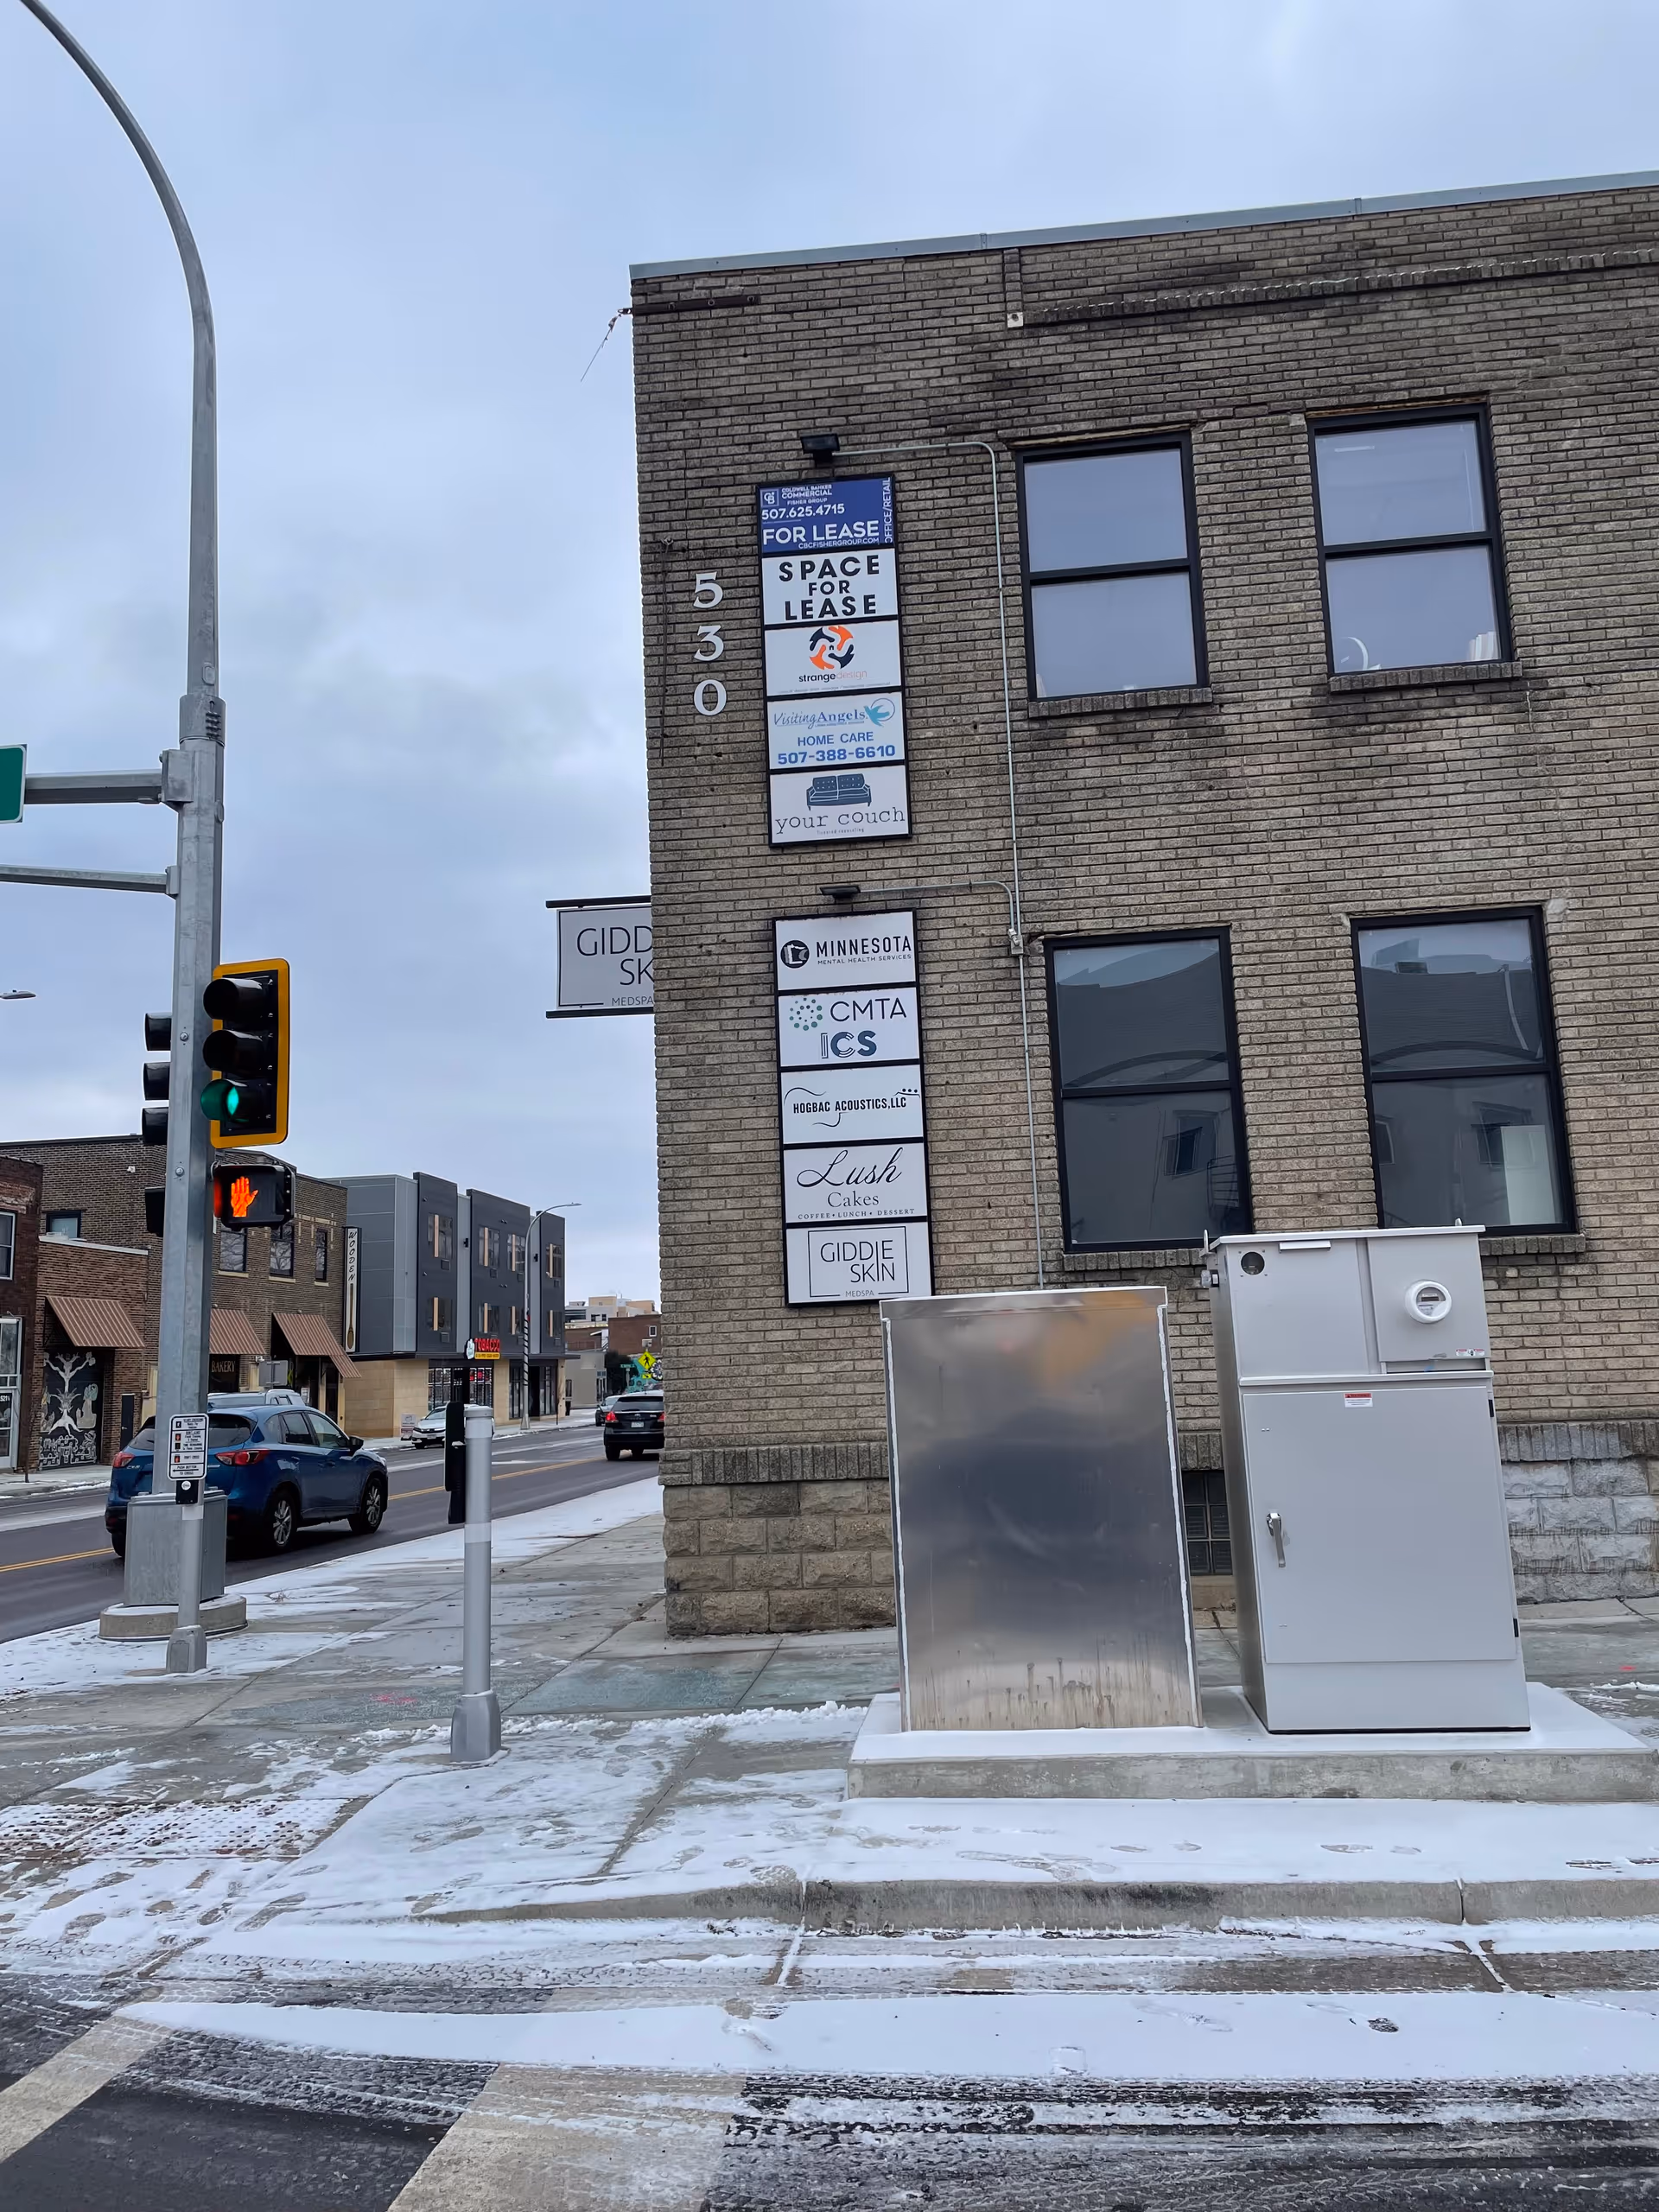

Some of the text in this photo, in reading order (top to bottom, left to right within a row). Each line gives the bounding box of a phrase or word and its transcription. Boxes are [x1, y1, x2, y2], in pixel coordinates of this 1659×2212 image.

[781, 489, 833, 499] COMMERCIAL
[761, 503, 845, 520] 507.625.4715
[882, 477, 893, 543] OFFICE/RETAIL
[762, 519, 880, 545] FOR LEASE
[798, 537, 880, 550] CBCFISHERGROUP.COM
[779, 555, 880, 582] SPACE
[809, 580, 850, 596] FOR
[785, 594, 876, 621] LEASE
[693, 571, 728, 716] 530
[798, 731, 874, 747] HOME CARE
[778, 745, 896, 765] 507-388-6610
[775, 807, 906, 835] your couch
[817, 935, 912, 957] MINNESOTA
[611, 995, 655, 1007] MEDSPA
[830, 997, 907, 1022] CMTA
[821, 1030, 877, 1059] ICS
[793, 1101, 830, 1114] HOGBAC
[797, 1147, 904, 1188] Lush
[827, 1190, 880, 1208] Cakes
[877, 1208, 915, 1217] DESSERT
[347, 1231, 358, 1281] WOODEN
[820, 1240, 894, 1263] GIDDIE
[850, 1262, 895, 1283] SKIN
[845, 1289, 874, 1298] MEDSPA
[474, 1338, 500, 1352] TOBACCO
[211, 1360, 235, 1373] BAKERY
